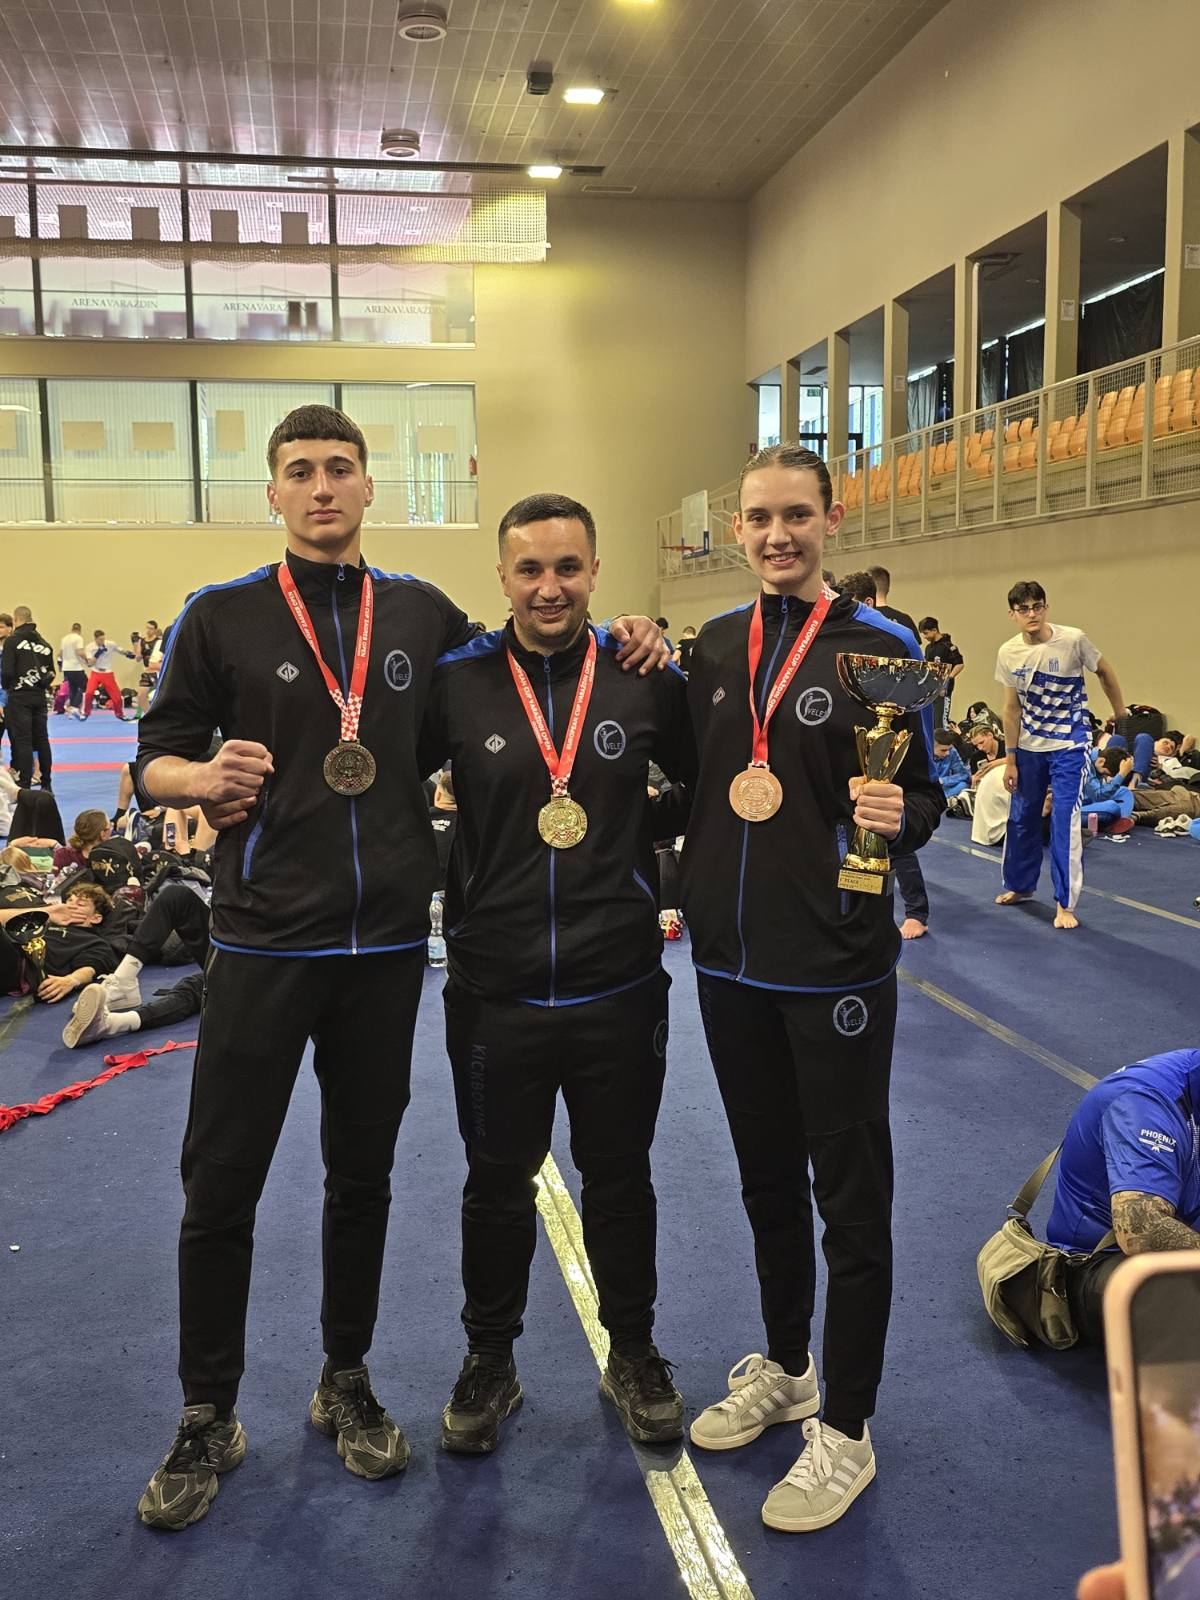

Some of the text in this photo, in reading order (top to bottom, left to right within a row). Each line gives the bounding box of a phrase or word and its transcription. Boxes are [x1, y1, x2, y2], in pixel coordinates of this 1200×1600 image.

[798, 620, 819, 653] EUROPEAN
[791, 652, 801, 667] CUP
[523, 685, 532, 700] CUP
[1140, 1128, 1177, 1146] PHOENIX
